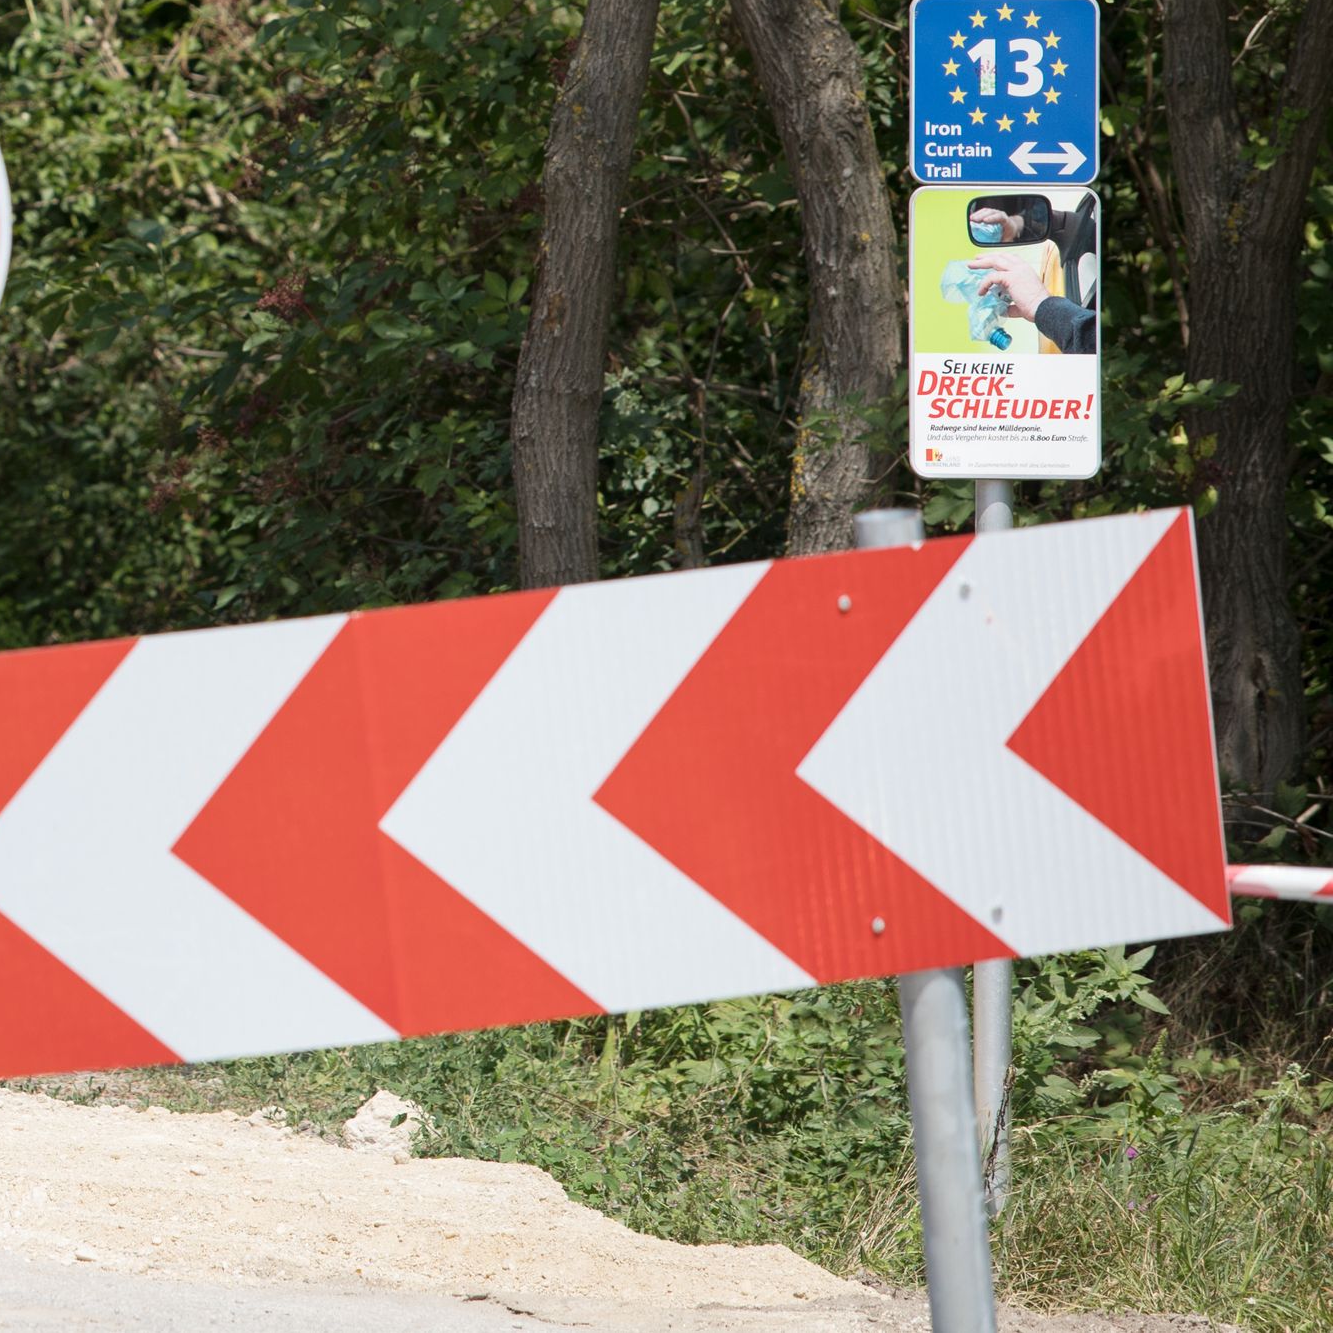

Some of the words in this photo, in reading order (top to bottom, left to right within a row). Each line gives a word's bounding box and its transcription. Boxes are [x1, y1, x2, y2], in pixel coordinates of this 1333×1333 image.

[966, 37, 1045, 98] 13
[924, 121, 962, 137] Iron
[924, 142, 993, 158] Curtain
[924, 163, 962, 178] Trail
[970, 362, 1015, 375] KEINE
[917, 370, 1015, 396] DRECK-
[928, 394, 1094, 420] SCHLEUDER!
[930, 424, 962, 433] Radwege
[963, 424, 978, 432] sind
[978, 424, 997, 432] keine
[927, 434, 942, 442] Und
[942, 434, 954, 442] das
[955, 434, 987, 444] Vergehen
[988, 434, 1009, 442] kostet
[1009, 434, 1020, 442] bis
[1051, 434, 1067, 442] Euro
